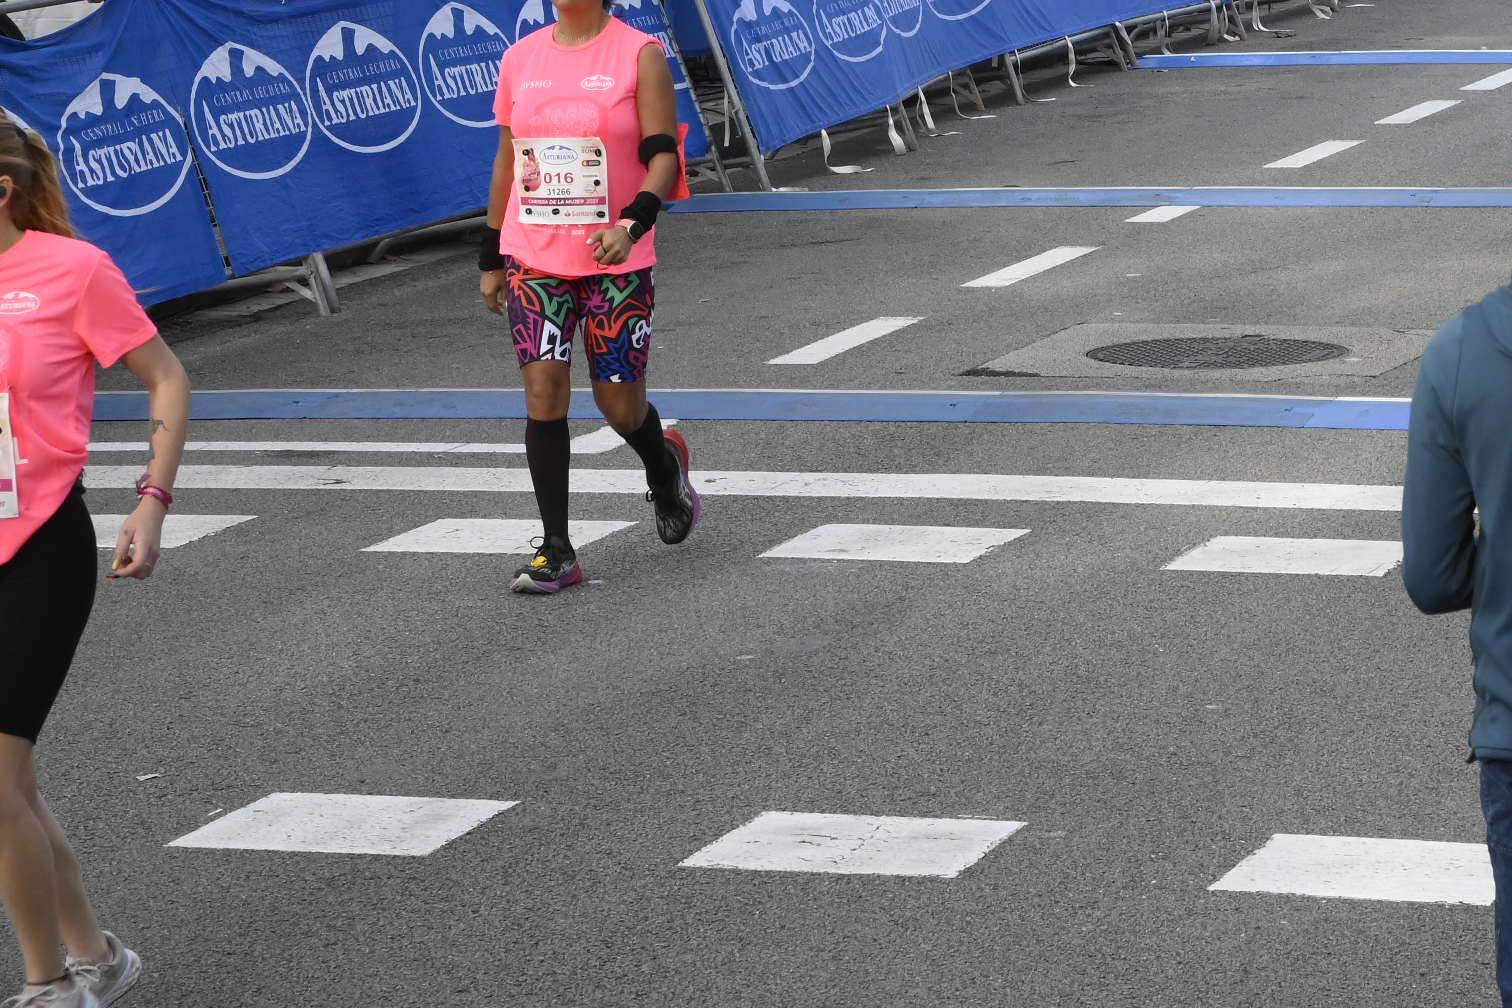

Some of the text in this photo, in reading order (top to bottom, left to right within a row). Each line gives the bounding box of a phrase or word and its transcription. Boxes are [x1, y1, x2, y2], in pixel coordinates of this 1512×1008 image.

[317, 72, 417, 127] ASTURIANA
[327, 67, 363, 84] CENTRAL
[429, 53, 502, 101] ASTURIA
[203, 99, 306, 152] ASTURIANA
[73, 126, 183, 189] ASTURIANA
[543, 172, 574, 184] 016
[546, 188, 571, 196] 31266
